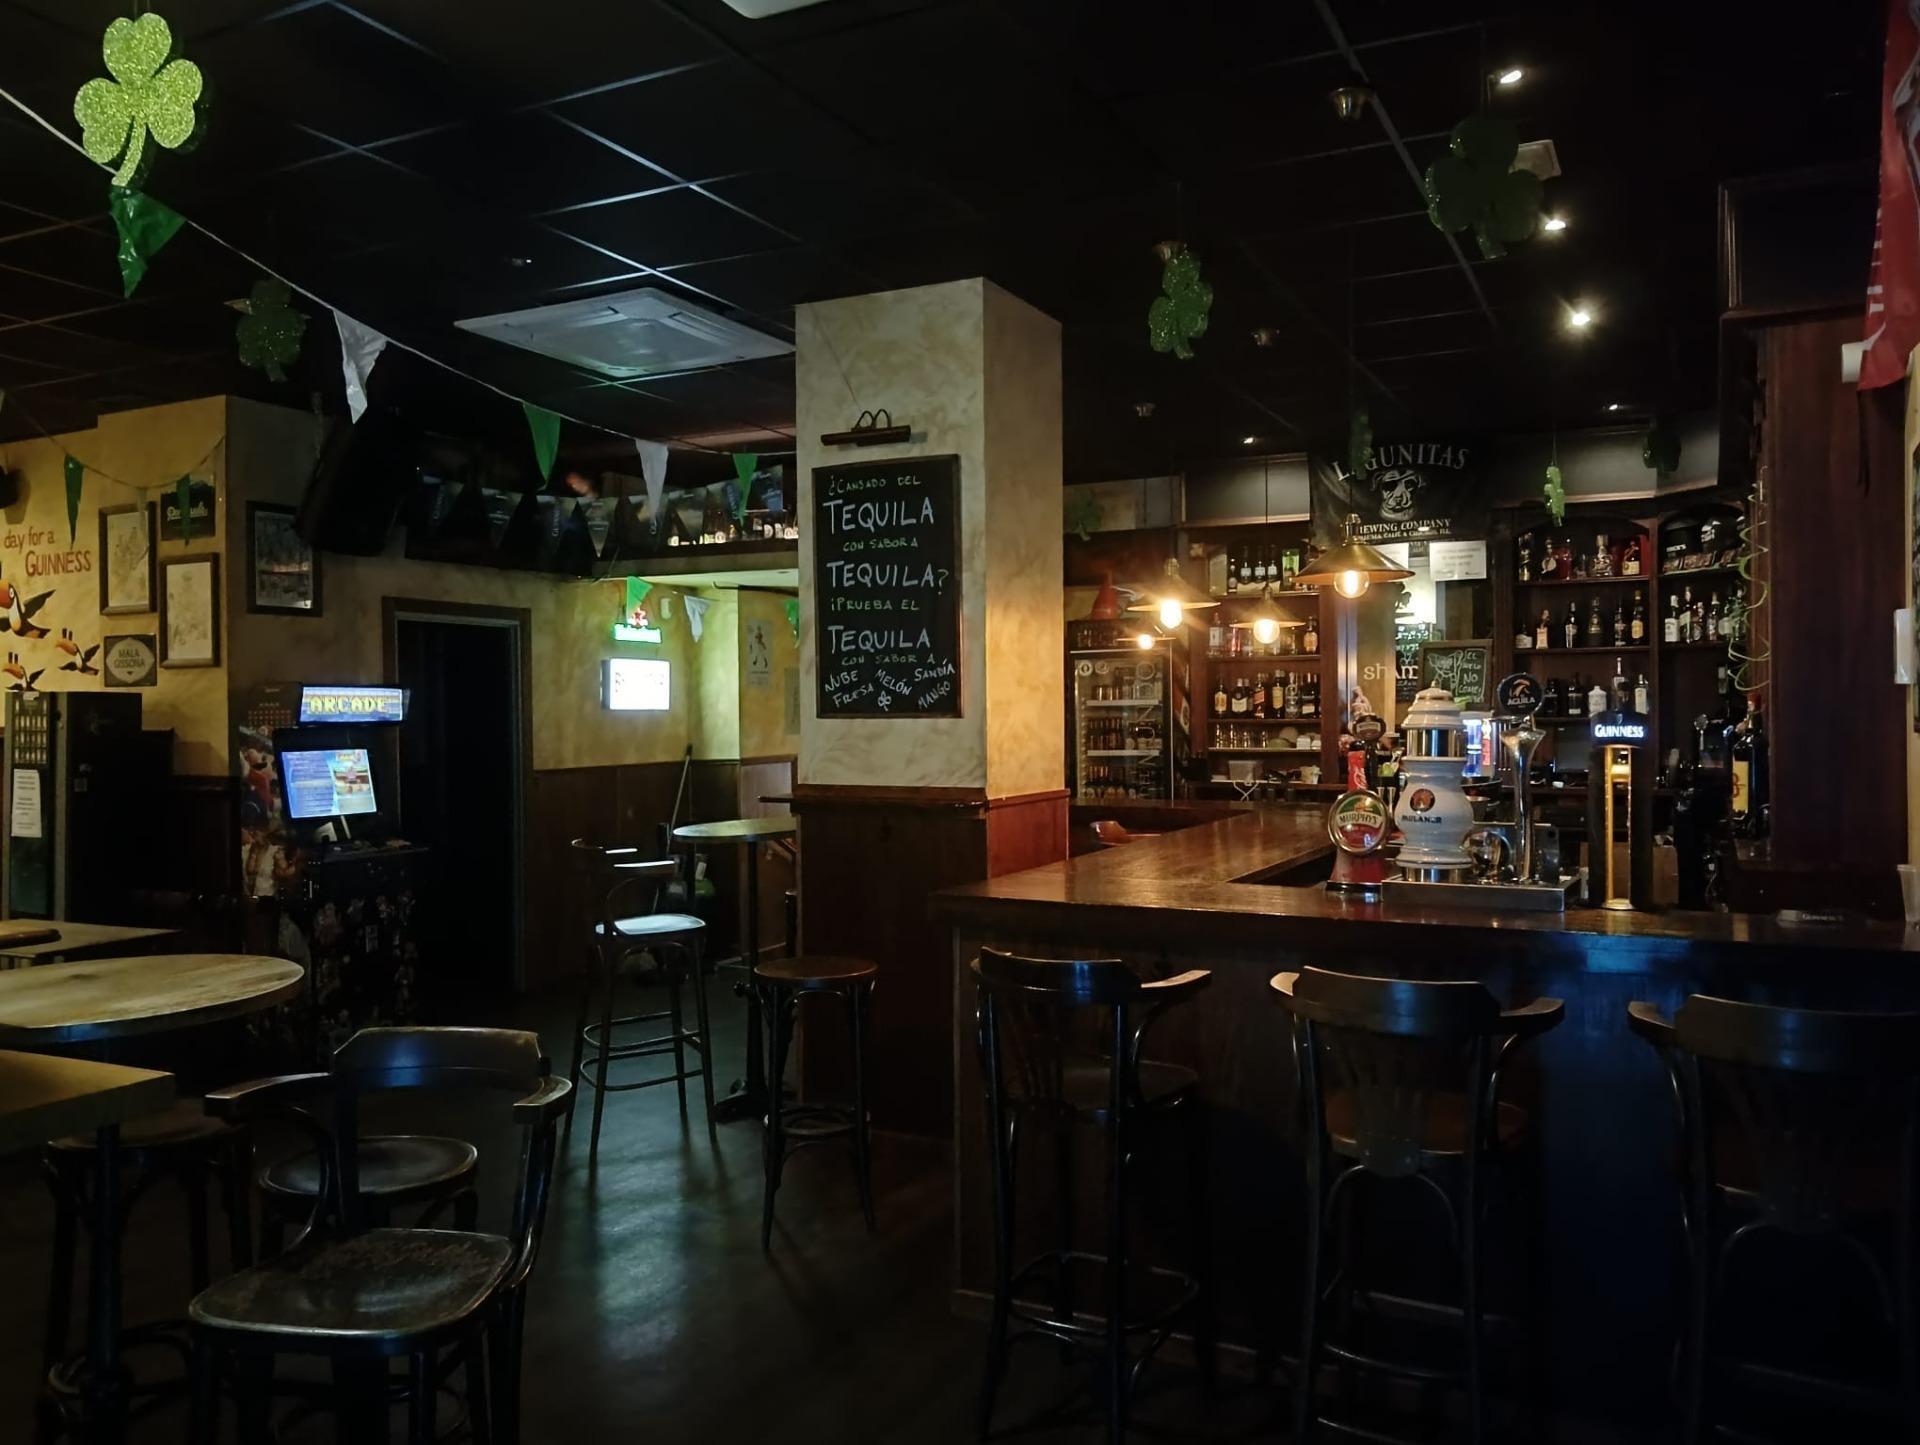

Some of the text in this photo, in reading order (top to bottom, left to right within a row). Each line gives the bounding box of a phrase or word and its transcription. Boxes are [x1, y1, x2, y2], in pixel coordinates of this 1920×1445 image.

[1331, 443, 1469, 481] LGUNITAS
[896, 475, 922, 487] DEL
[822, 496, 935, 535] TEQUILA
[4, 525, 55, 554] day for a
[843, 537, 919, 552] CON SABOR A
[25, 549, 92, 577] GUINNESS
[826, 559, 949, 595] TEQUILA?
[831, 596, 920, 612] ¡PRUEBA EL
[827, 624, 931, 654] TEQUILA
[841, 653, 936, 666] CON SABOR A
[914, 658, 956, 682] SANDÍA
[824, 670, 859, 692] NUBE
[874, 669, 912, 696] MELÓN
[309, 695, 388, 714] ARCADE
[832, 683, 875, 708] FRESA
[918, 681, 950, 709] MANGO
[1594, 724, 1645, 738] GUINNESS
